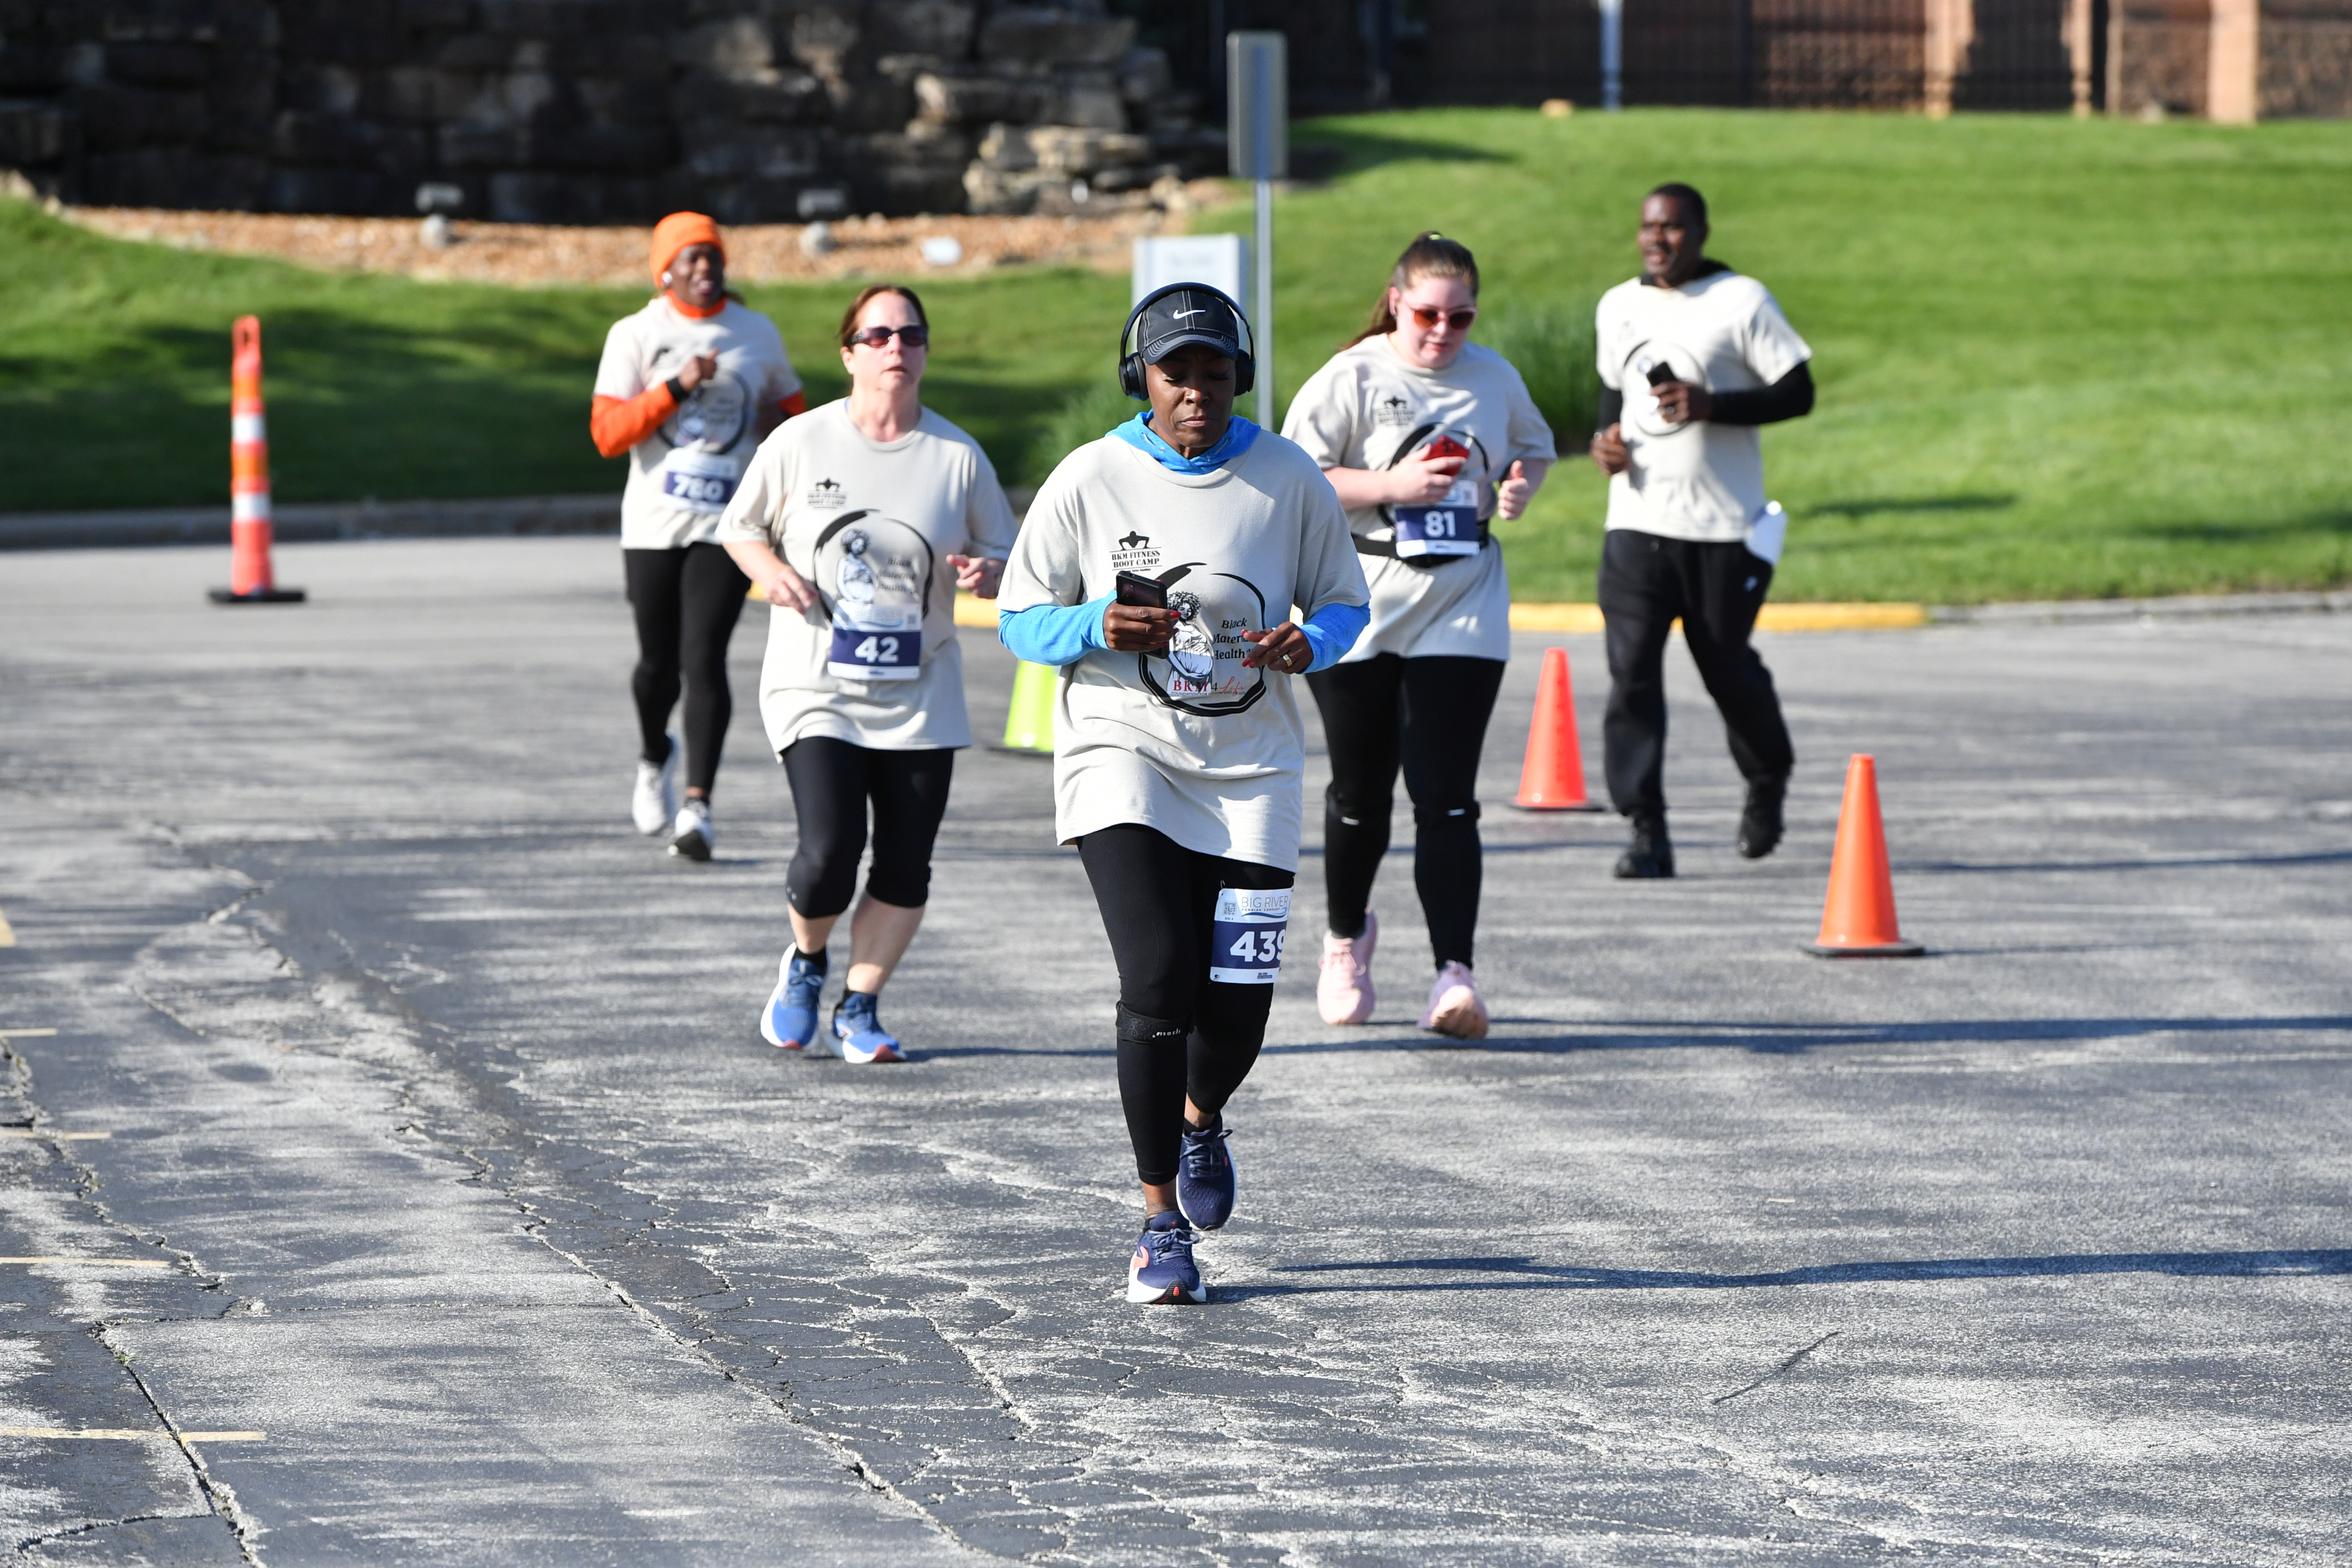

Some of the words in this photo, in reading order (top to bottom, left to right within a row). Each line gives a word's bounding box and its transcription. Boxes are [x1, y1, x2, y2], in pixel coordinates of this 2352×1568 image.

[1424, 511, 1456, 537] 81
[1111, 553, 1127, 561] BKM
[1130, 550, 1160, 558] FITNESS
[1113, 560, 1134, 568] BOOT
[1221, 618, 1247, 629] Black
[855, 636, 899, 663] 42
[1211, 682, 1218, 691] 4
[1220, 676, 1245, 696] Life
[1241, 897, 1261, 908] BIG
[1264, 896, 1288, 908] RIVER
[1230, 929, 1286, 962] 439
